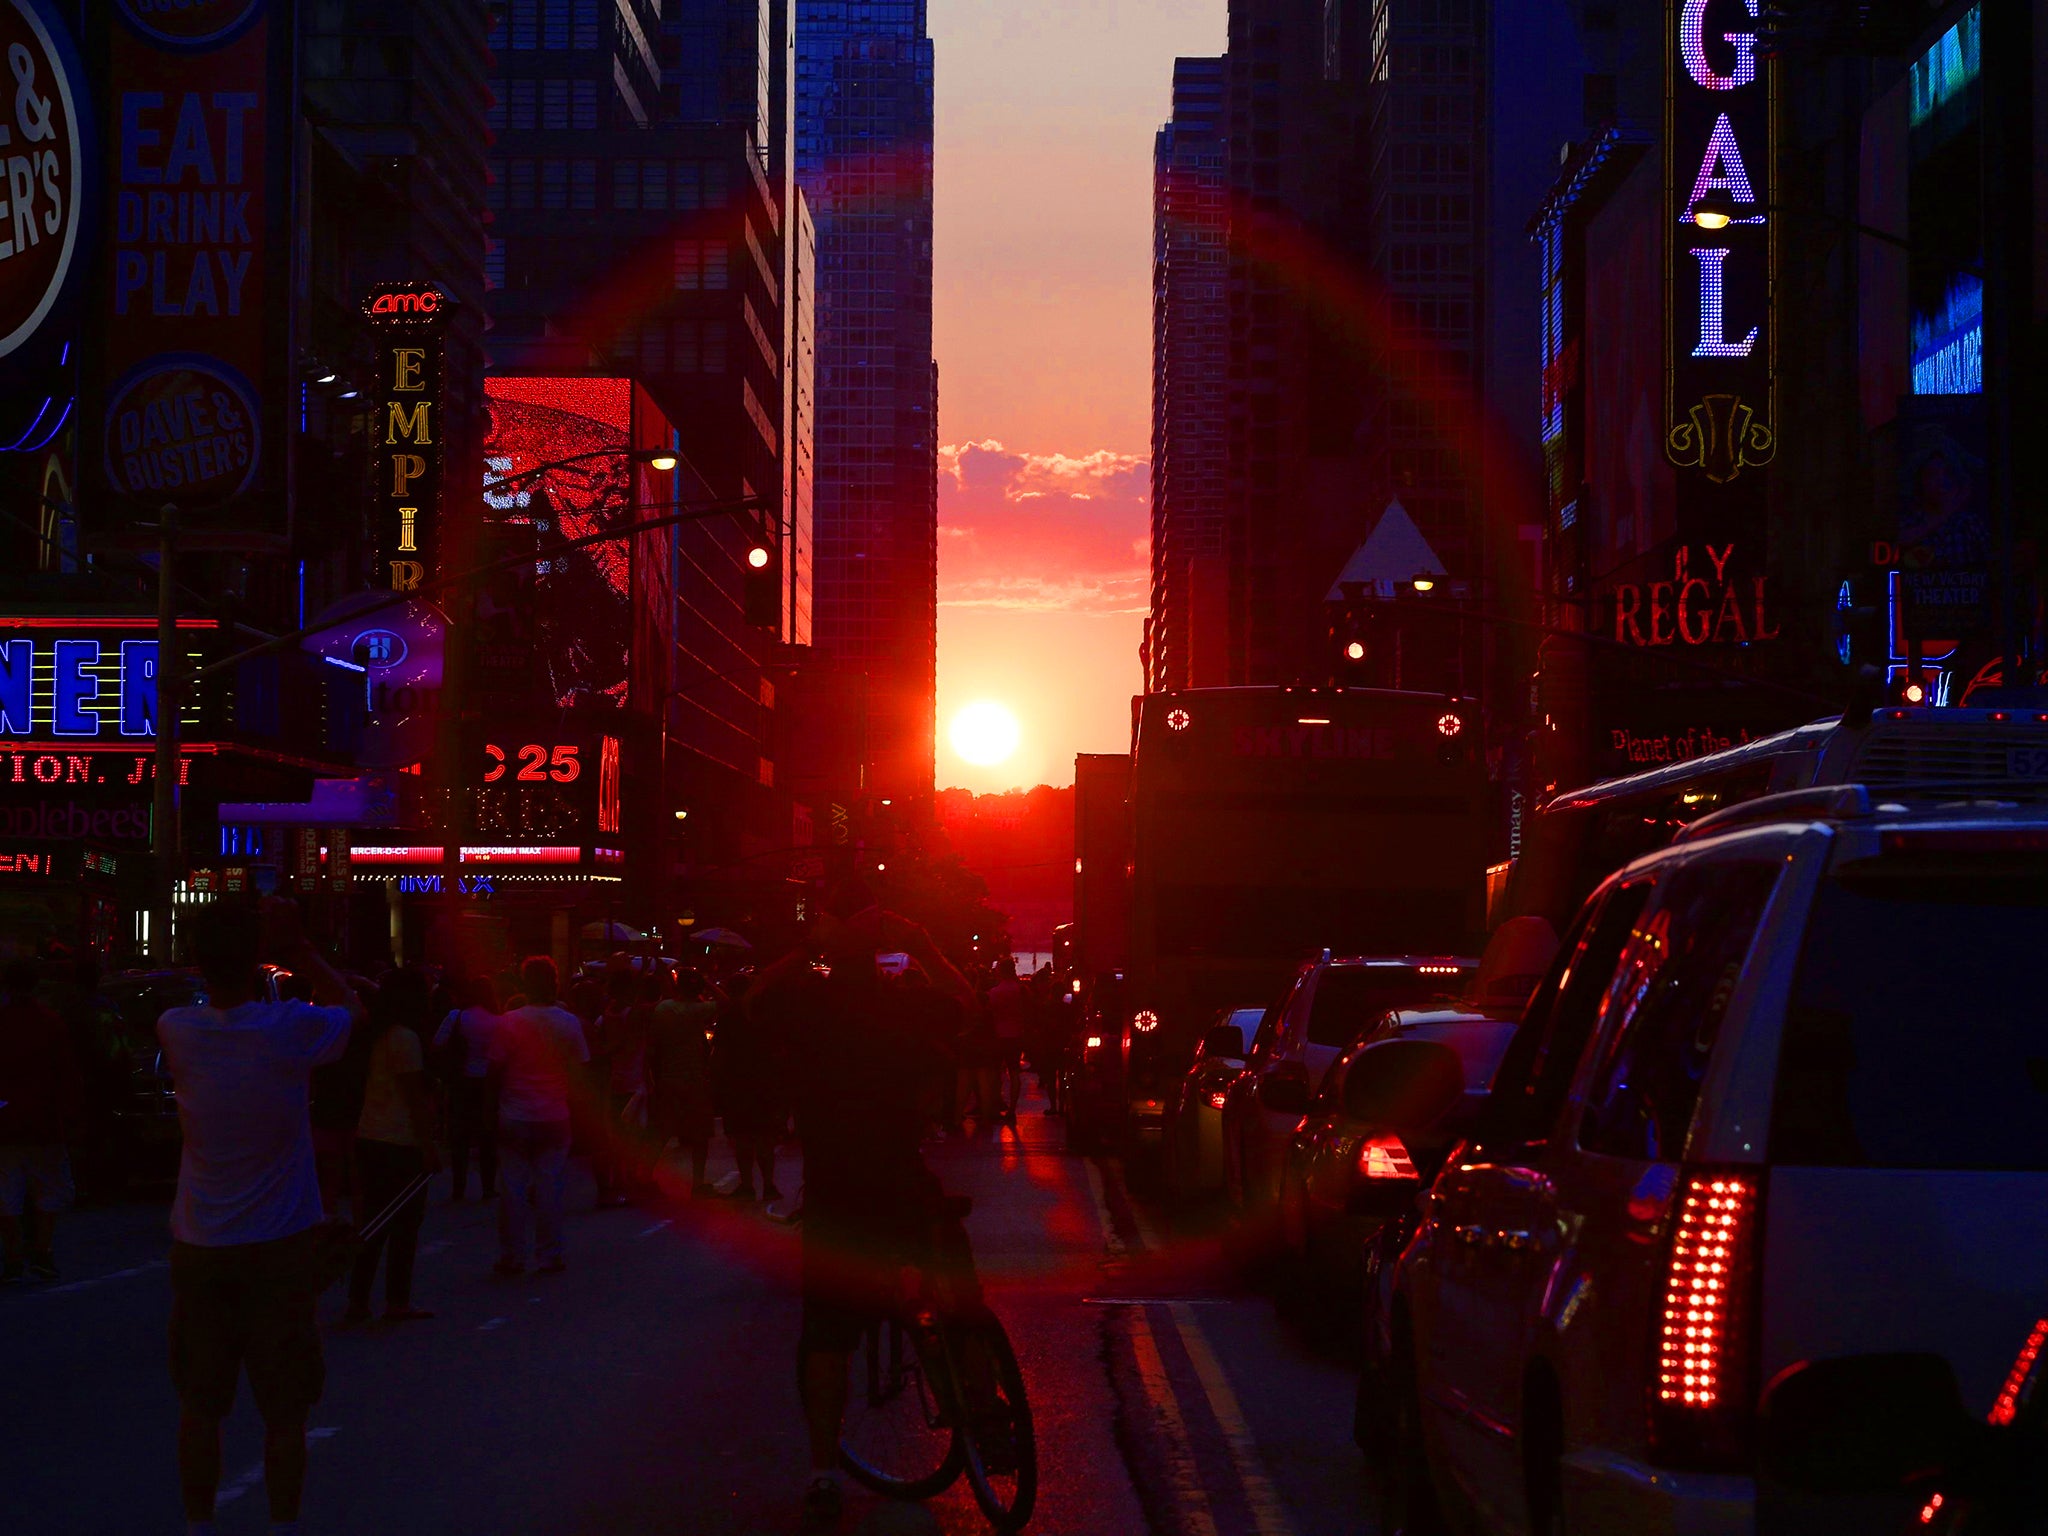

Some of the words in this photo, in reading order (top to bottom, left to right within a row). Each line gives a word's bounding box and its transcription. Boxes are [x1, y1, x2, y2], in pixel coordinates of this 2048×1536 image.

[120, 92, 258, 185] EAT
[118, 191, 252, 245] DRINK
[114, 250, 253, 317] PLAY
[119, 393, 215, 455] DAVE
[210, 391, 245, 432] &
[122, 430, 249, 492] BUSTER'S
[1612, 574, 1782, 647] REGAL
[0, 755, 105, 784] ION.
[517, 744, 581, 783] 25
[1610, 729, 1673, 763] Planet
[1675, 727, 1696, 758] of
[1700, 726, 1731, 753] the
[1510, 788, 1527, 861] rmacy
